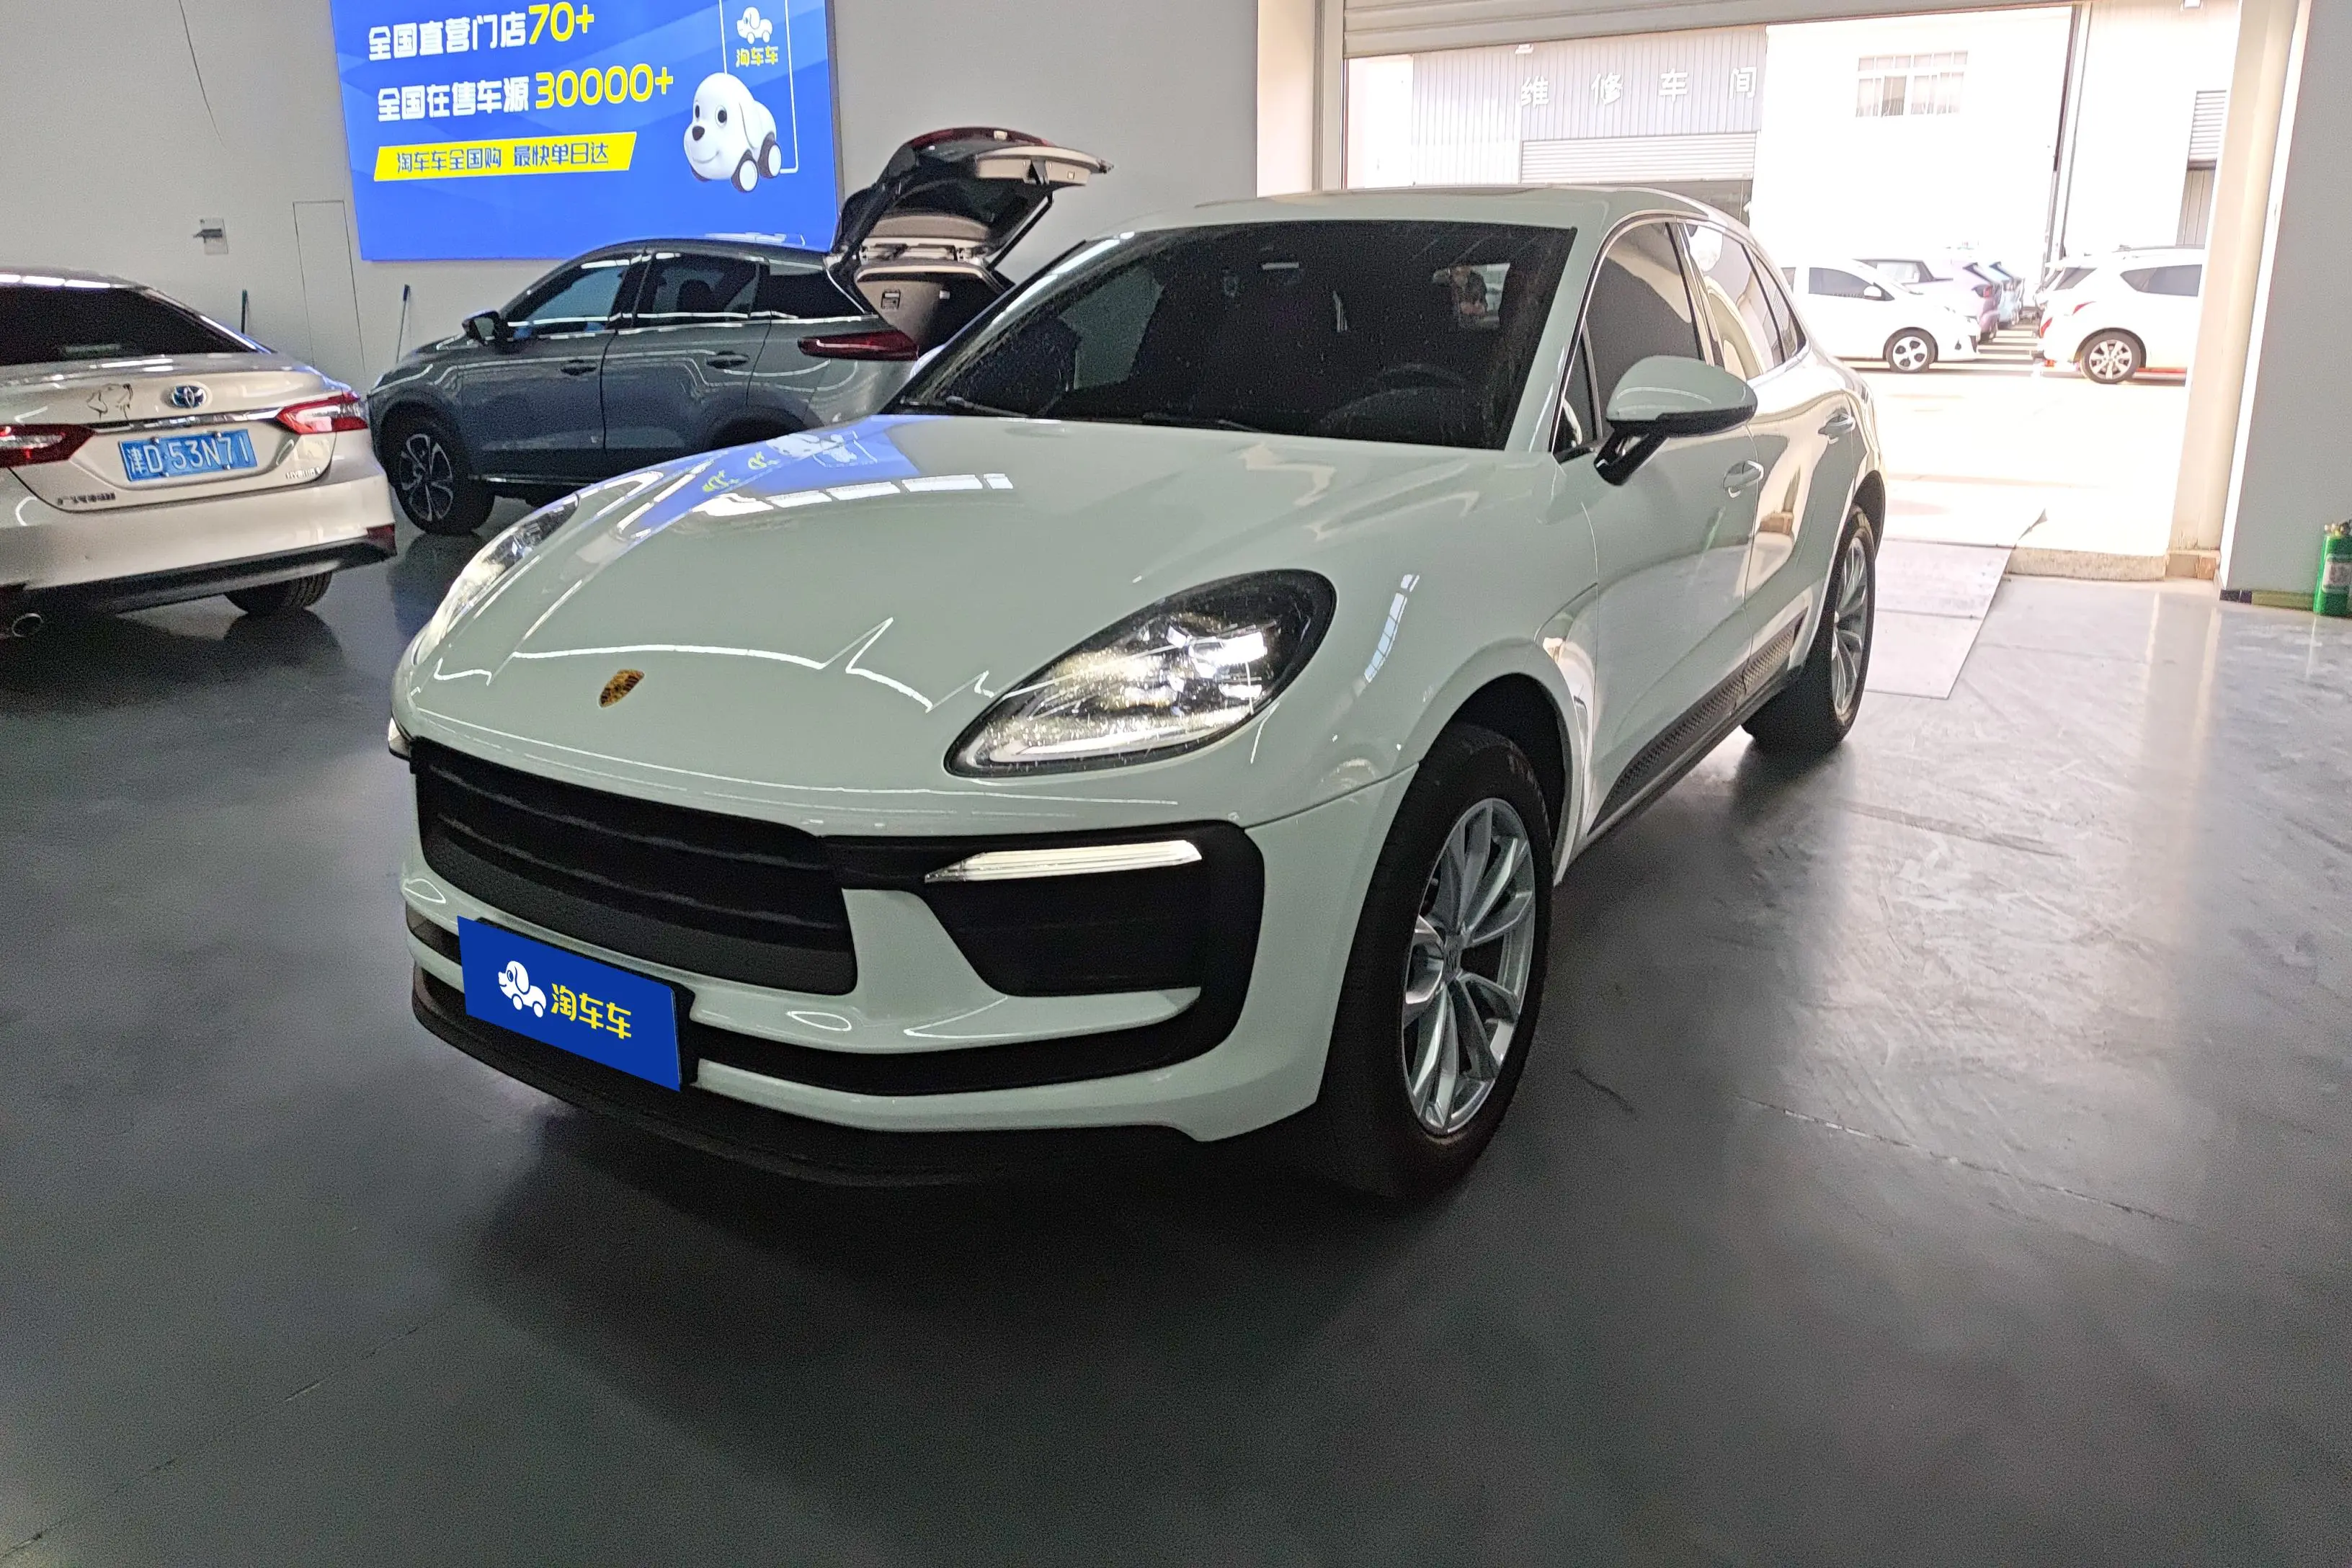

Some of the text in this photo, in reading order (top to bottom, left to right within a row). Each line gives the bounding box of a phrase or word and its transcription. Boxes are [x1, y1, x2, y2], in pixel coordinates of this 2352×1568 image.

[736, 45, 778, 68] 淘车车
[1520, 66, 1758, 107] 维修车间
[396, 141, 610, 174] 淘车车全国购 最快单日达
